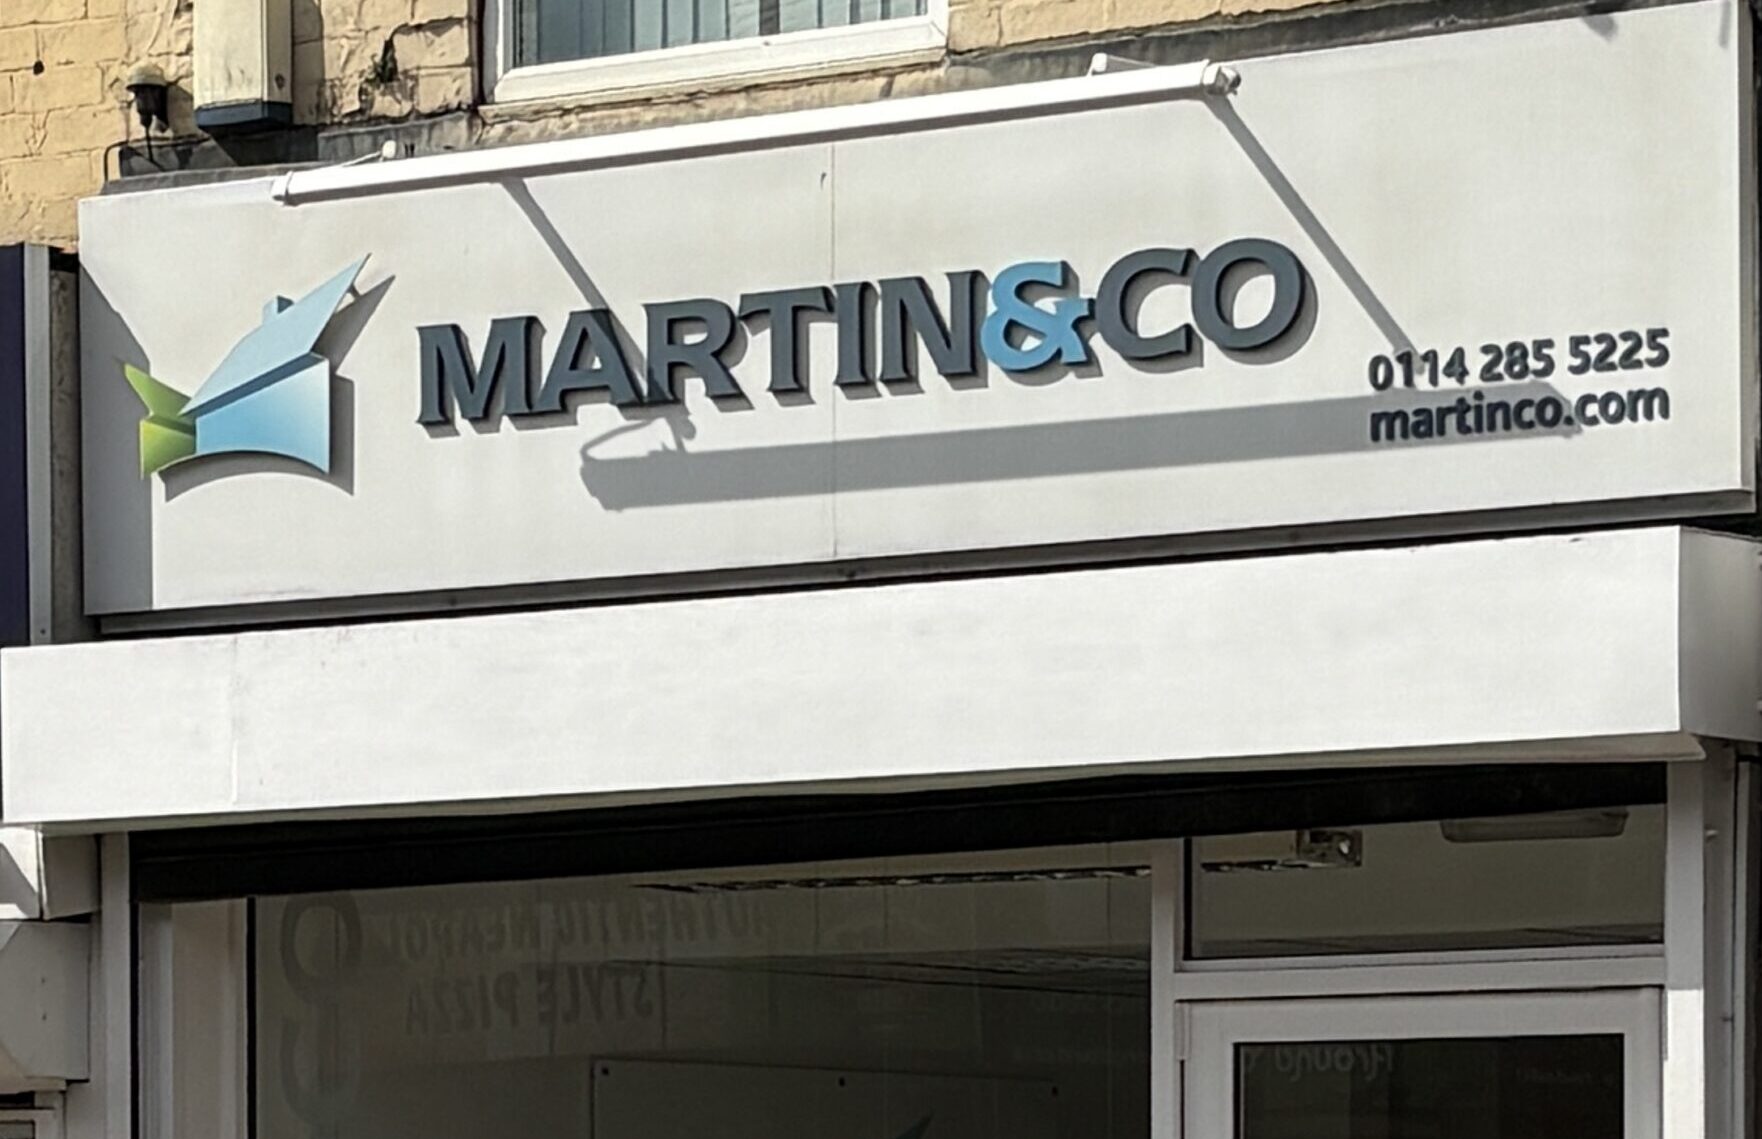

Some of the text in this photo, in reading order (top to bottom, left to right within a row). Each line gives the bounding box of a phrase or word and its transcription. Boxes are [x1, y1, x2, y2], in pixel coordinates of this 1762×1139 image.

[416, 237, 1309, 425] MARTIN&CO
[1368, 327, 1671, 391] 0114 285 5225
[1370, 387, 1671, 443] martinco.com
